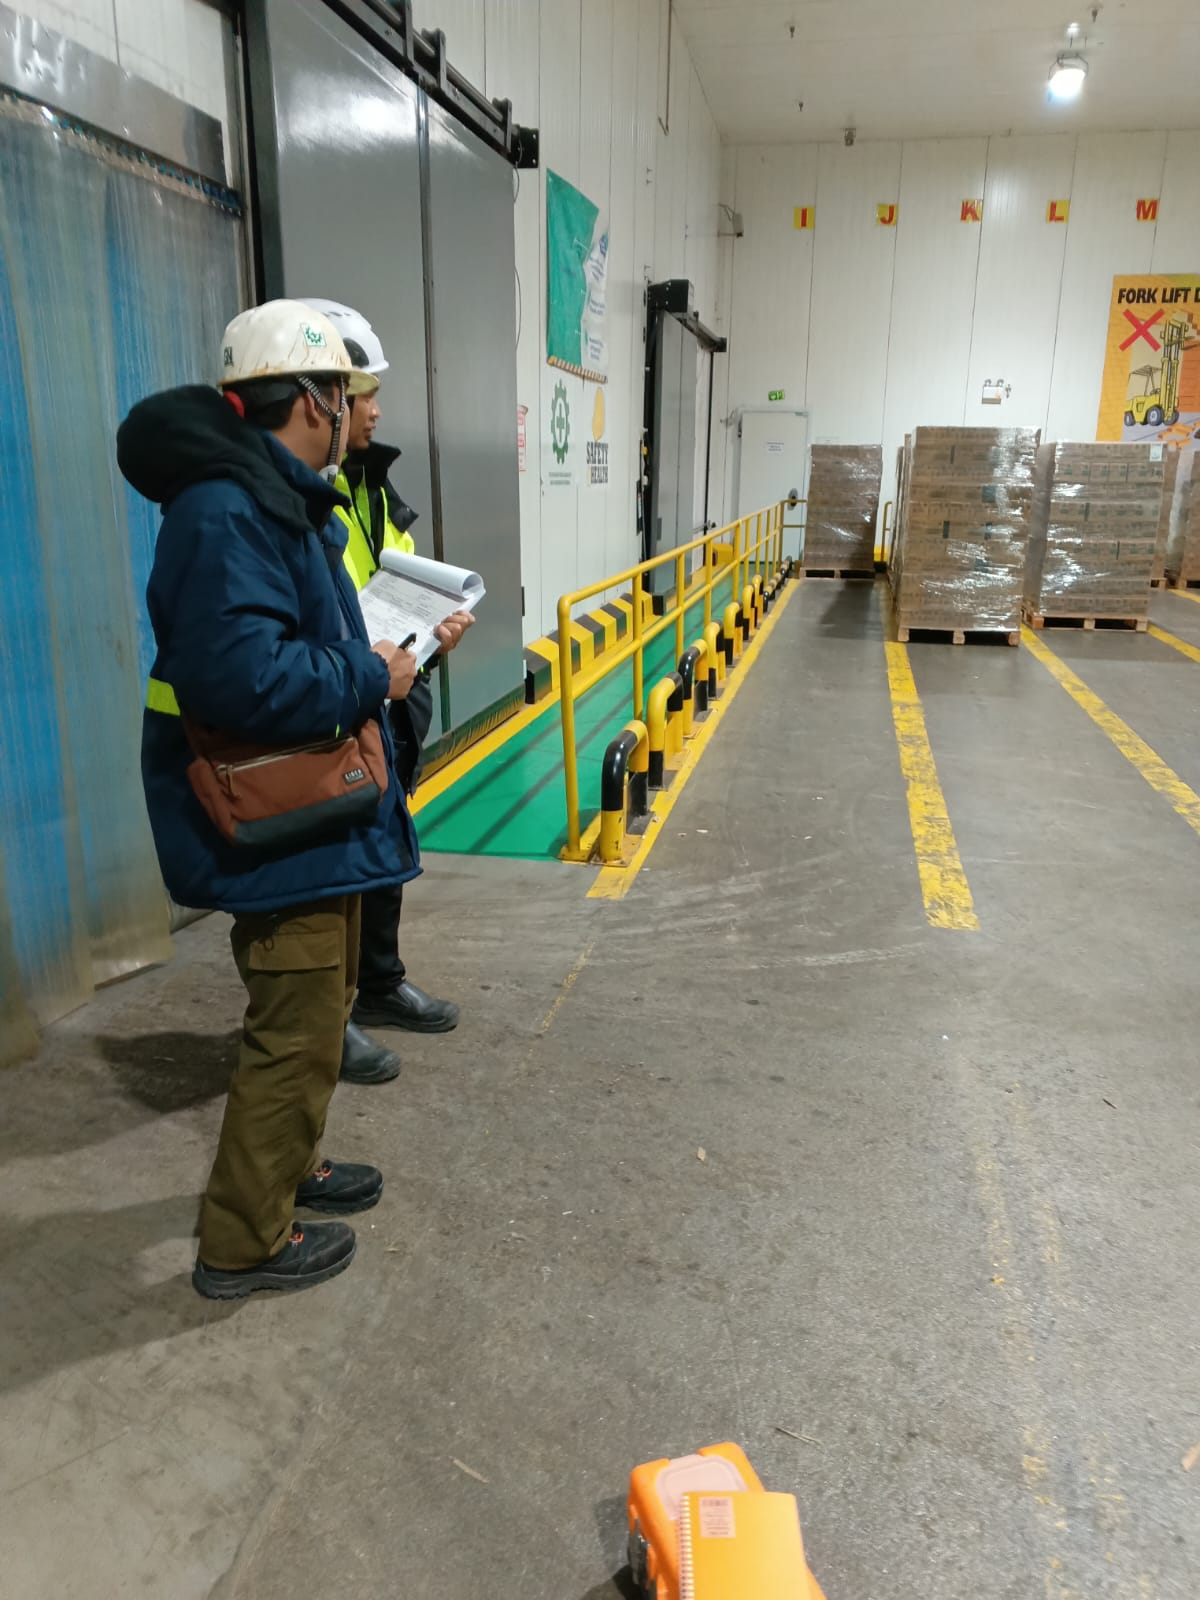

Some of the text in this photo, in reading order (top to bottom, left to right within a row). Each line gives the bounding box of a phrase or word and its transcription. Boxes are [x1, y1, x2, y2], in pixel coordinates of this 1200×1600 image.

[801, 208, 807, 227] I
[880, 205, 895, 224] J
[960, 200, 979, 221] K
[1049, 202, 1065, 221] L
[1137, 200, 1158, 220] M
[1117, 287, 1158, 304] FORK
[1161, 287, 1191, 303] LIFT
